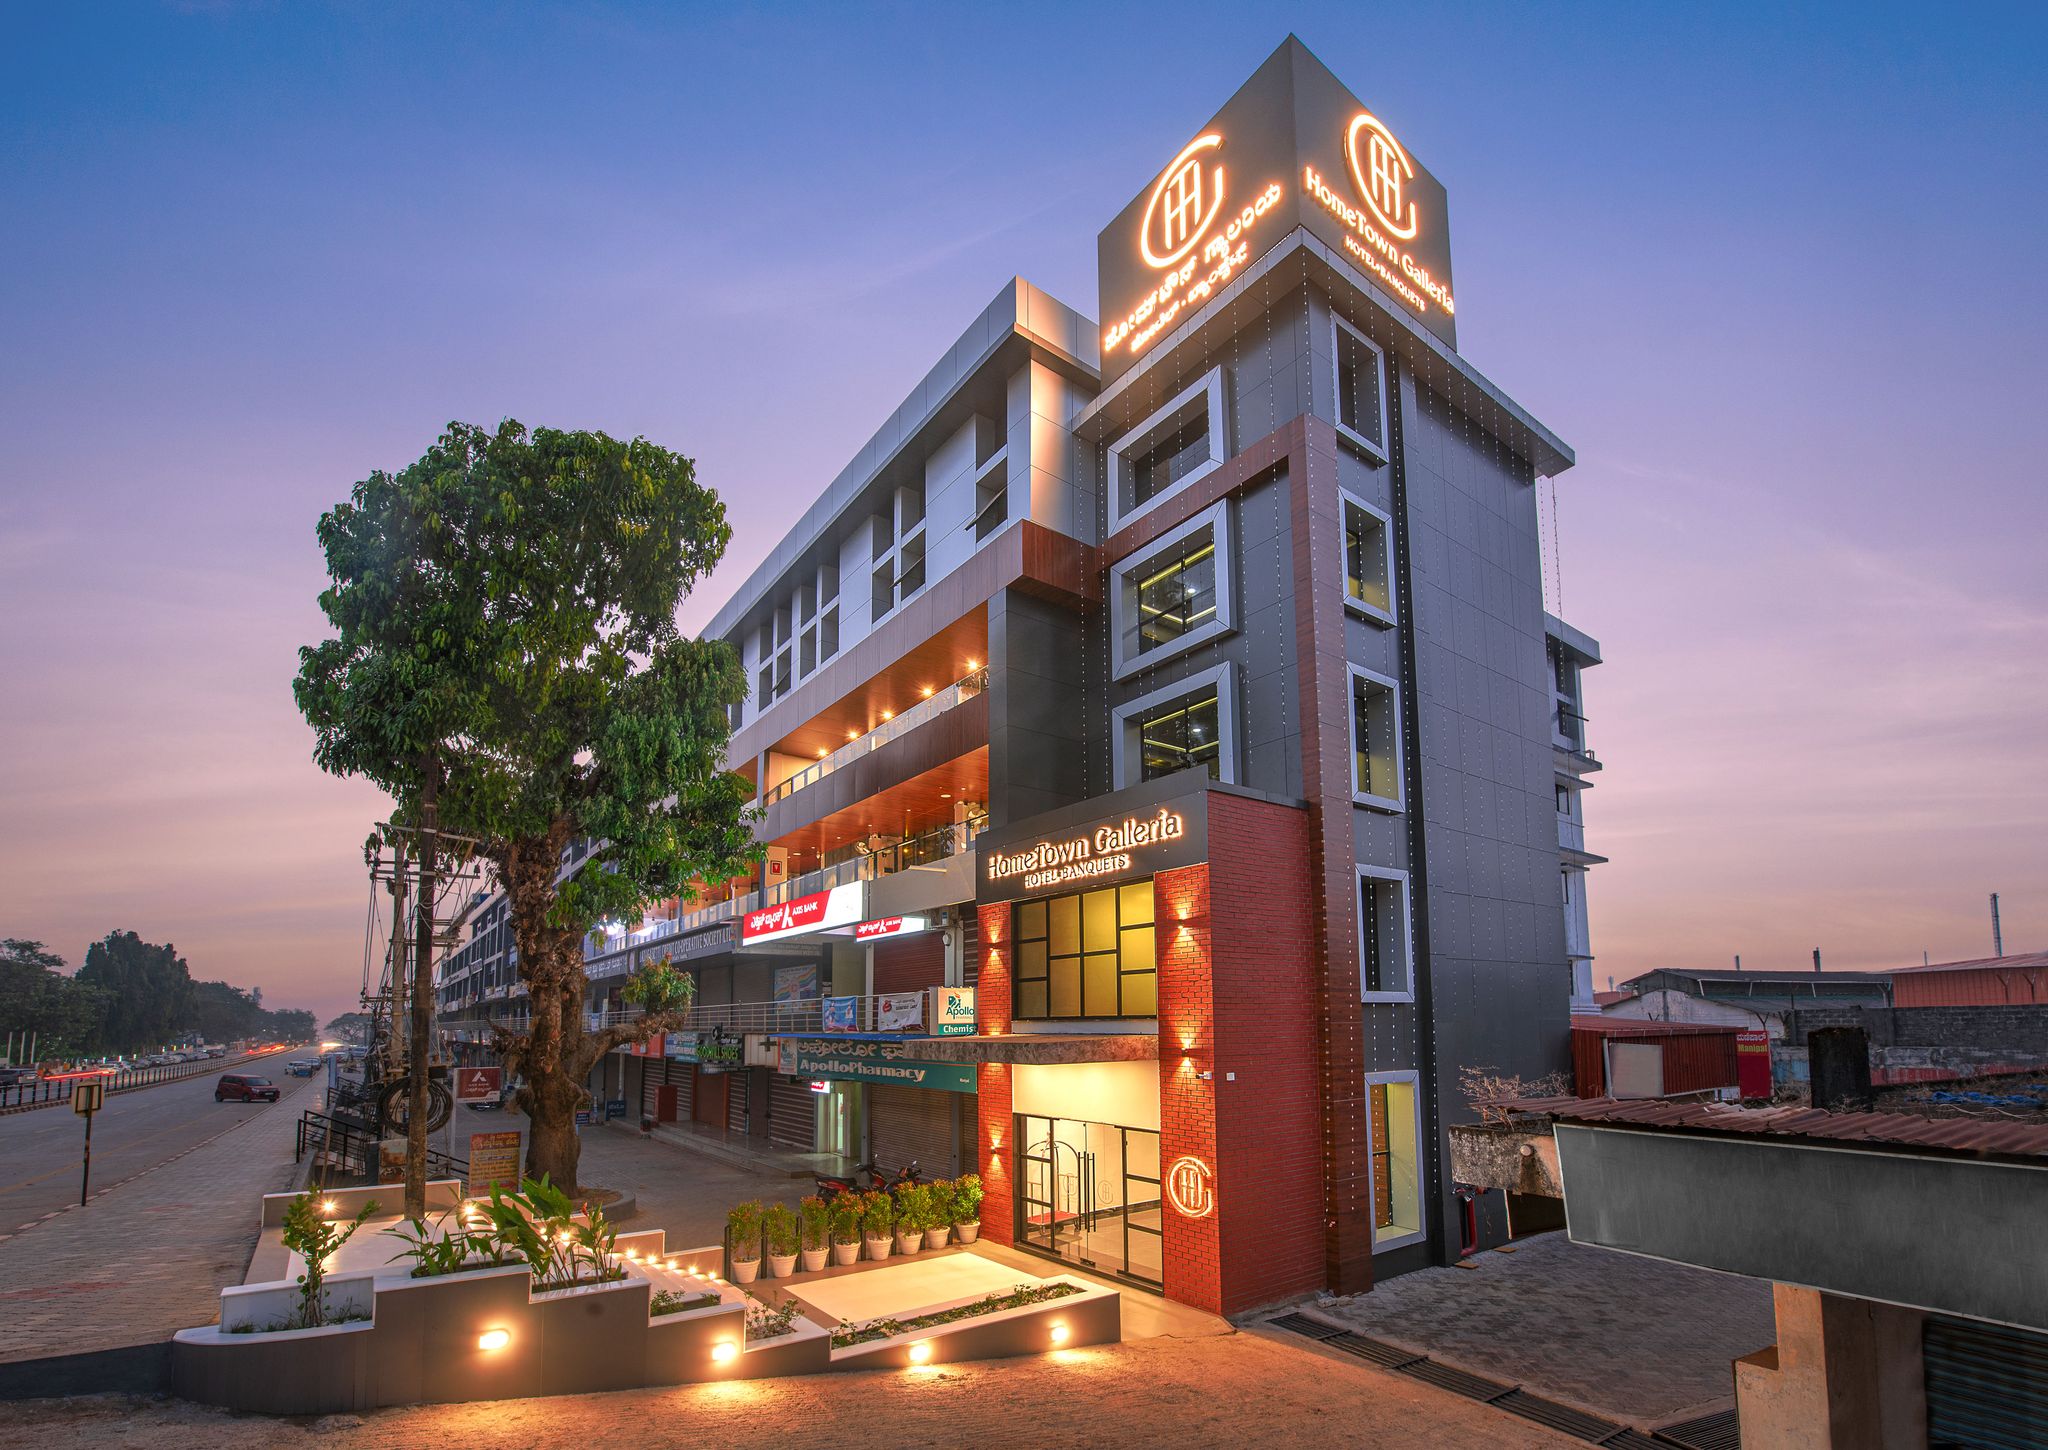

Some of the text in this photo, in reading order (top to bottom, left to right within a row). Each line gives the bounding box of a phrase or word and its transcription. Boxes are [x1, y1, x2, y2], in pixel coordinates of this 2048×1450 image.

[1305, 166, 1455, 314] HomeTown Galleria
[989, 808, 1183, 879] HomeTown Galleria
[1024, 854, 1130, 889] HOTEL BANQUETS
[792, 901, 818, 916] AXIS BANK
[946, 1006, 975, 1020] Apollo
